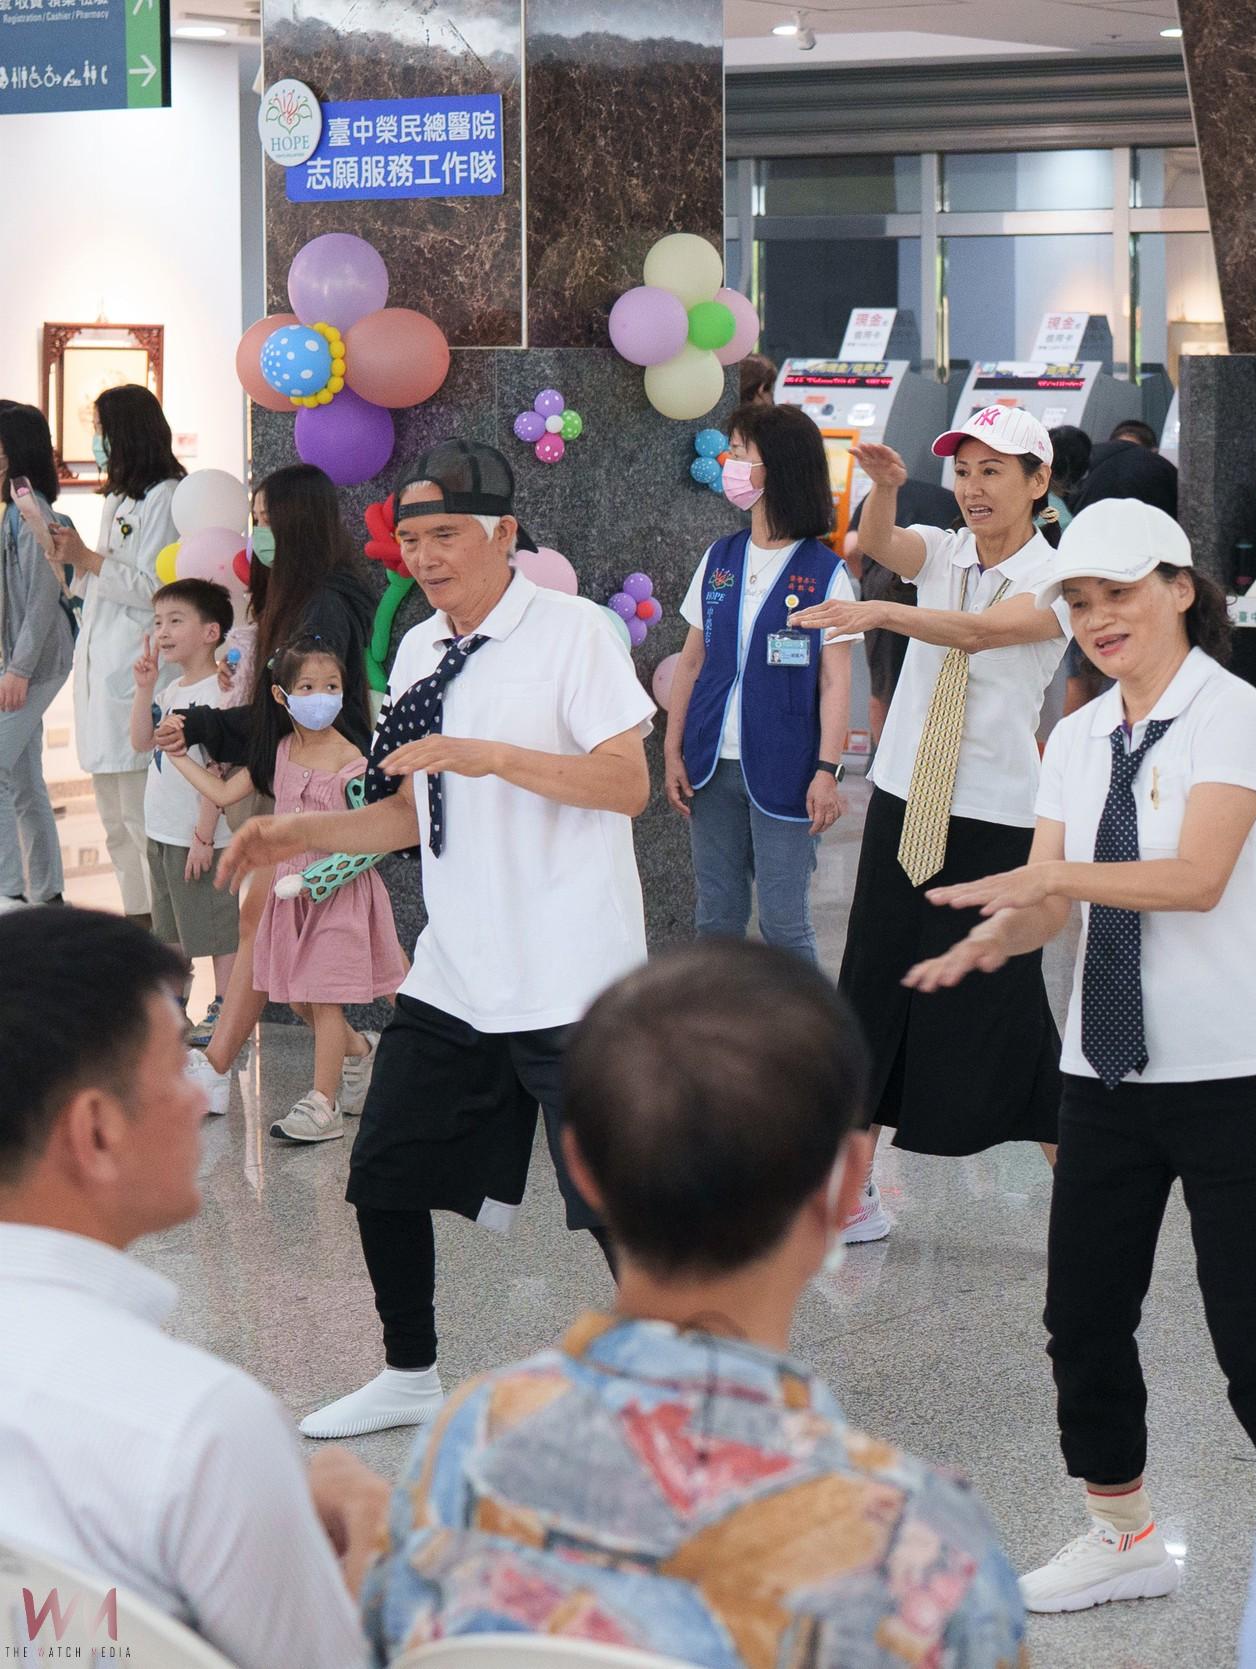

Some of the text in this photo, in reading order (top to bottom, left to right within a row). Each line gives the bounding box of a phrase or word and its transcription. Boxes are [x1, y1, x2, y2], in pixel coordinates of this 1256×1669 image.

[3, 13, 42, 25] Registration
[46, 12, 70, 21] Cashier
[76, 10, 109, 20] Pharmacy
[327, 110, 496, 147] 臺中榮民總醫院
[271, 135, 310, 152] HOPE
[306, 150, 497, 190] 志願服務工作隊
